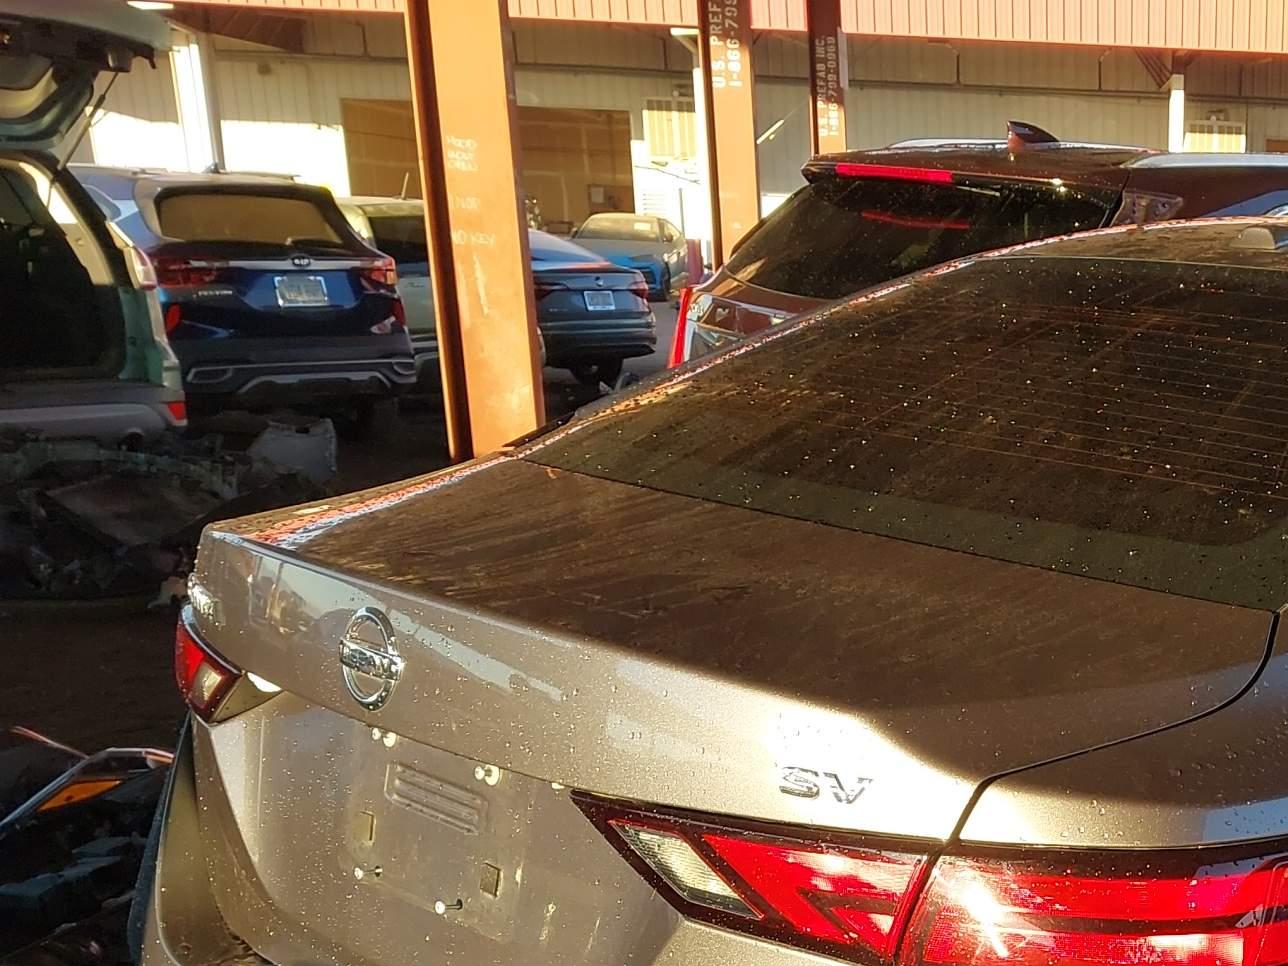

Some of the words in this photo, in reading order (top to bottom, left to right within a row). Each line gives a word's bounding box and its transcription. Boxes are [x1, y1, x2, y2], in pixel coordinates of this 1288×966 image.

[711, 56, 727, 88] U.S.
[815, 63, 828, 108] PREFAB
[779, 766, 874, 804] SV
